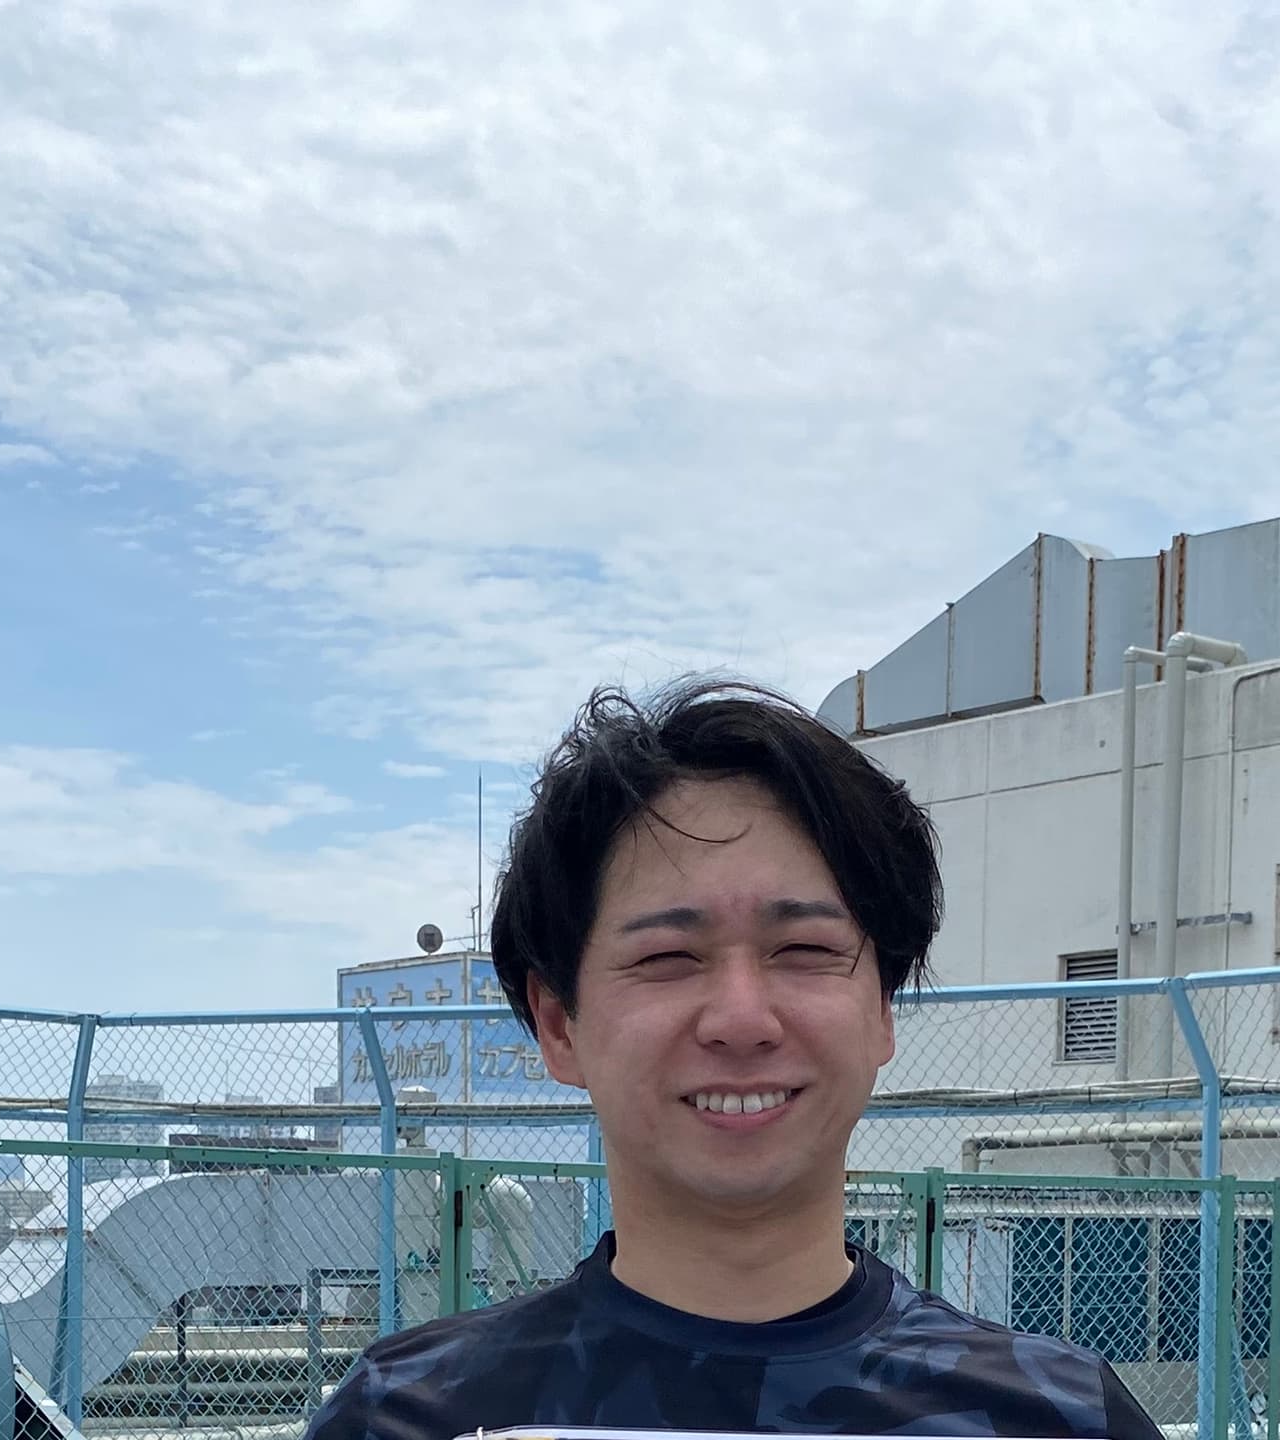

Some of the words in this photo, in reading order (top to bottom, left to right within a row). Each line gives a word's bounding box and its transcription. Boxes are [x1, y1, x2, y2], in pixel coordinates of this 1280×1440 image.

[352, 1040, 451, 1083] カセルホテル
